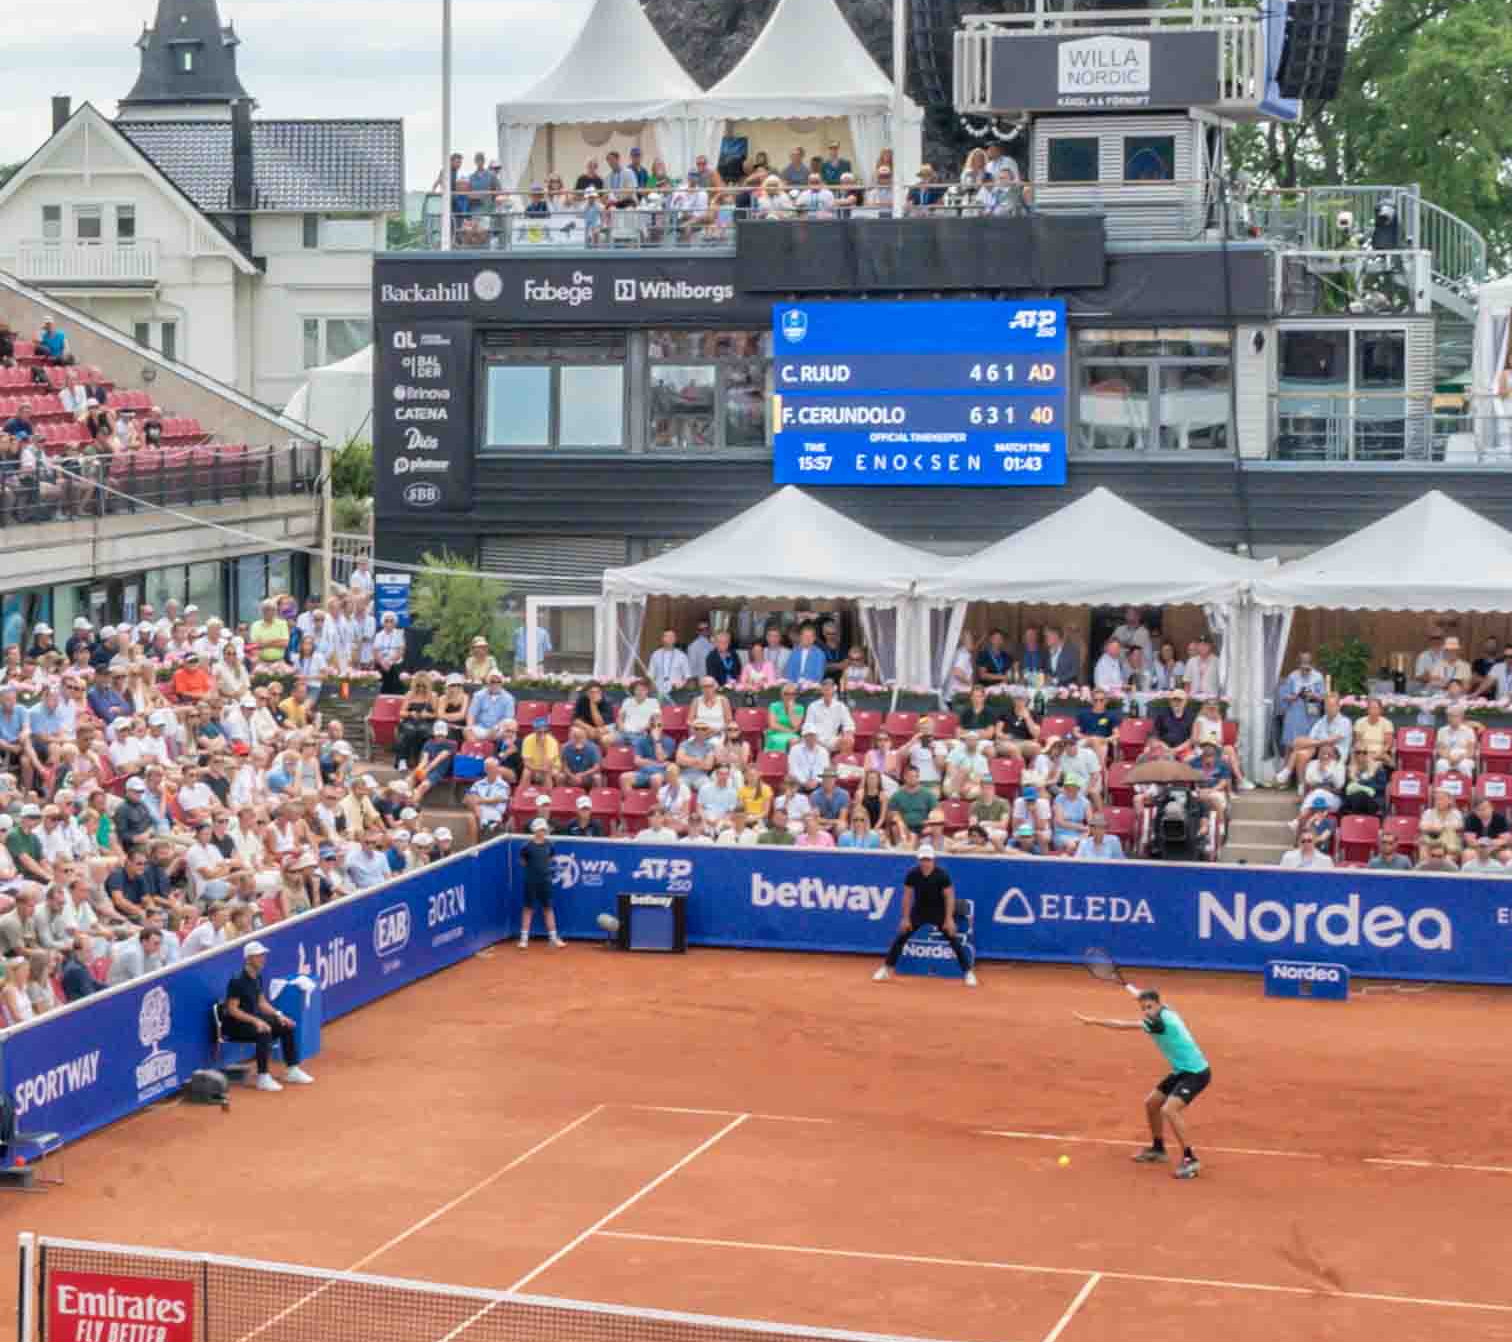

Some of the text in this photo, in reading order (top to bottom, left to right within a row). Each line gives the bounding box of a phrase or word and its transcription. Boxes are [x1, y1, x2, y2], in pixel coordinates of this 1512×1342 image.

[1069, 48, 1139, 67] WILLA
[1067, 69, 1141, 85] NORDIC
[381, 283, 469, 302] Backahill
[524, 278, 593, 306] Fabege
[640, 281, 733, 302] Wihlborgs
[1009, 310, 1056, 328] ATP
[801, 365, 850, 381] RUUD
[970, 365, 981, 380] 4
[987, 365, 999, 380] 6
[1005, 365, 1014, 380] 1
[1028, 364, 1056, 380] AD
[395, 409, 448, 420] CATENA
[799, 407, 905, 423] CERUNDOLO
[970, 407, 982, 423] 6
[987, 407, 998, 423] 3
[1006, 407, 1014, 423] 1
[1029, 407, 1054, 423] 40
[869, 433, 909, 443] OFFICIAL
[798, 456, 832, 470] 15:57
[1003, 456, 1042, 470] 01:43
[409, 486, 436, 501] SBB
[582, 859, 617, 875] WTA
[632, 858, 693, 881] ATP
[666, 879, 693, 892] 250
[630, 895, 674, 908] betway
[751, 873, 896, 921] betway
[1040, 895, 1155, 924] ELEDA
[378, 911, 408, 949] EAB
[1198, 891, 1453, 950] Nordea
[903, 942, 957, 960] Norde
[315, 937, 357, 990] bilia
[1272, 964, 1339, 984] Nordea
[15, 1050, 100, 1116] SPORTWAY
[57, 1285, 186, 1323] Emirates
[76, 1319, 104, 1342] FLY
